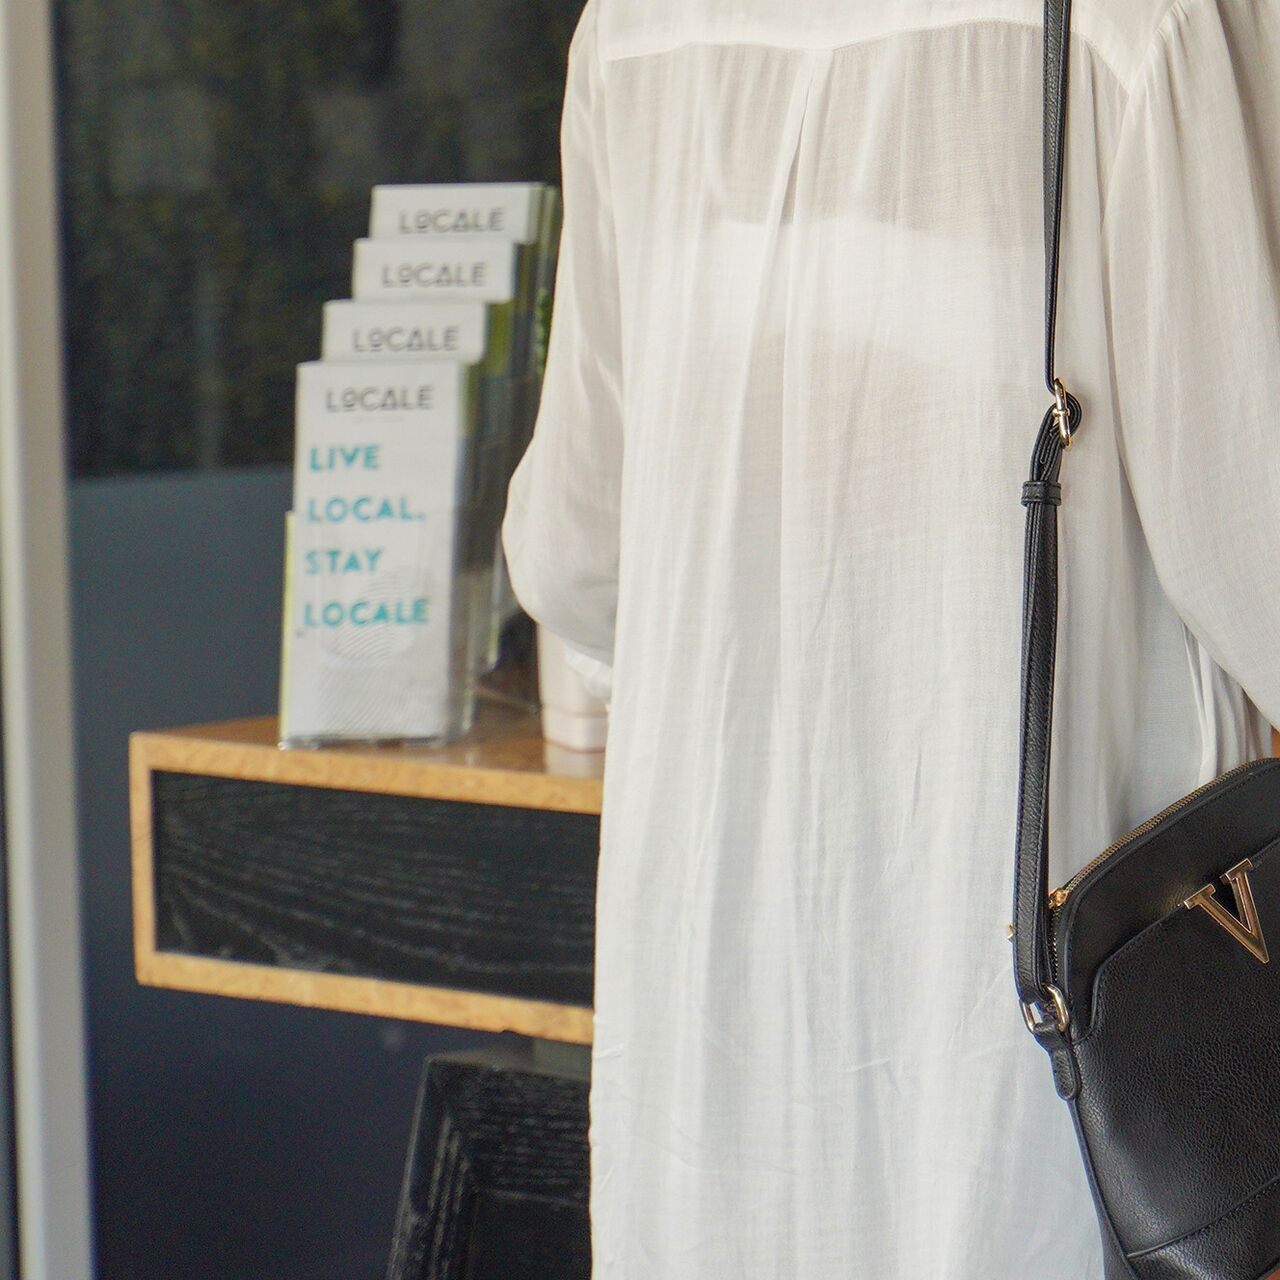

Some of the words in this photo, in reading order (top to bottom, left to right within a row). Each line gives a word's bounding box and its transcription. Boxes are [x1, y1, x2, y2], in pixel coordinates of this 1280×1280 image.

[399, 207, 504, 234] LOCALE
[381, 261, 487, 288] LOCALE
[353, 326, 460, 353] LOCALE
[325, 387, 433, 414] LOCALE
[310, 444, 381, 471] LIVE
[307, 497, 425, 523] LOCAL.
[305, 549, 384, 576] STAY
[303, 598, 430, 628] LOCALE
